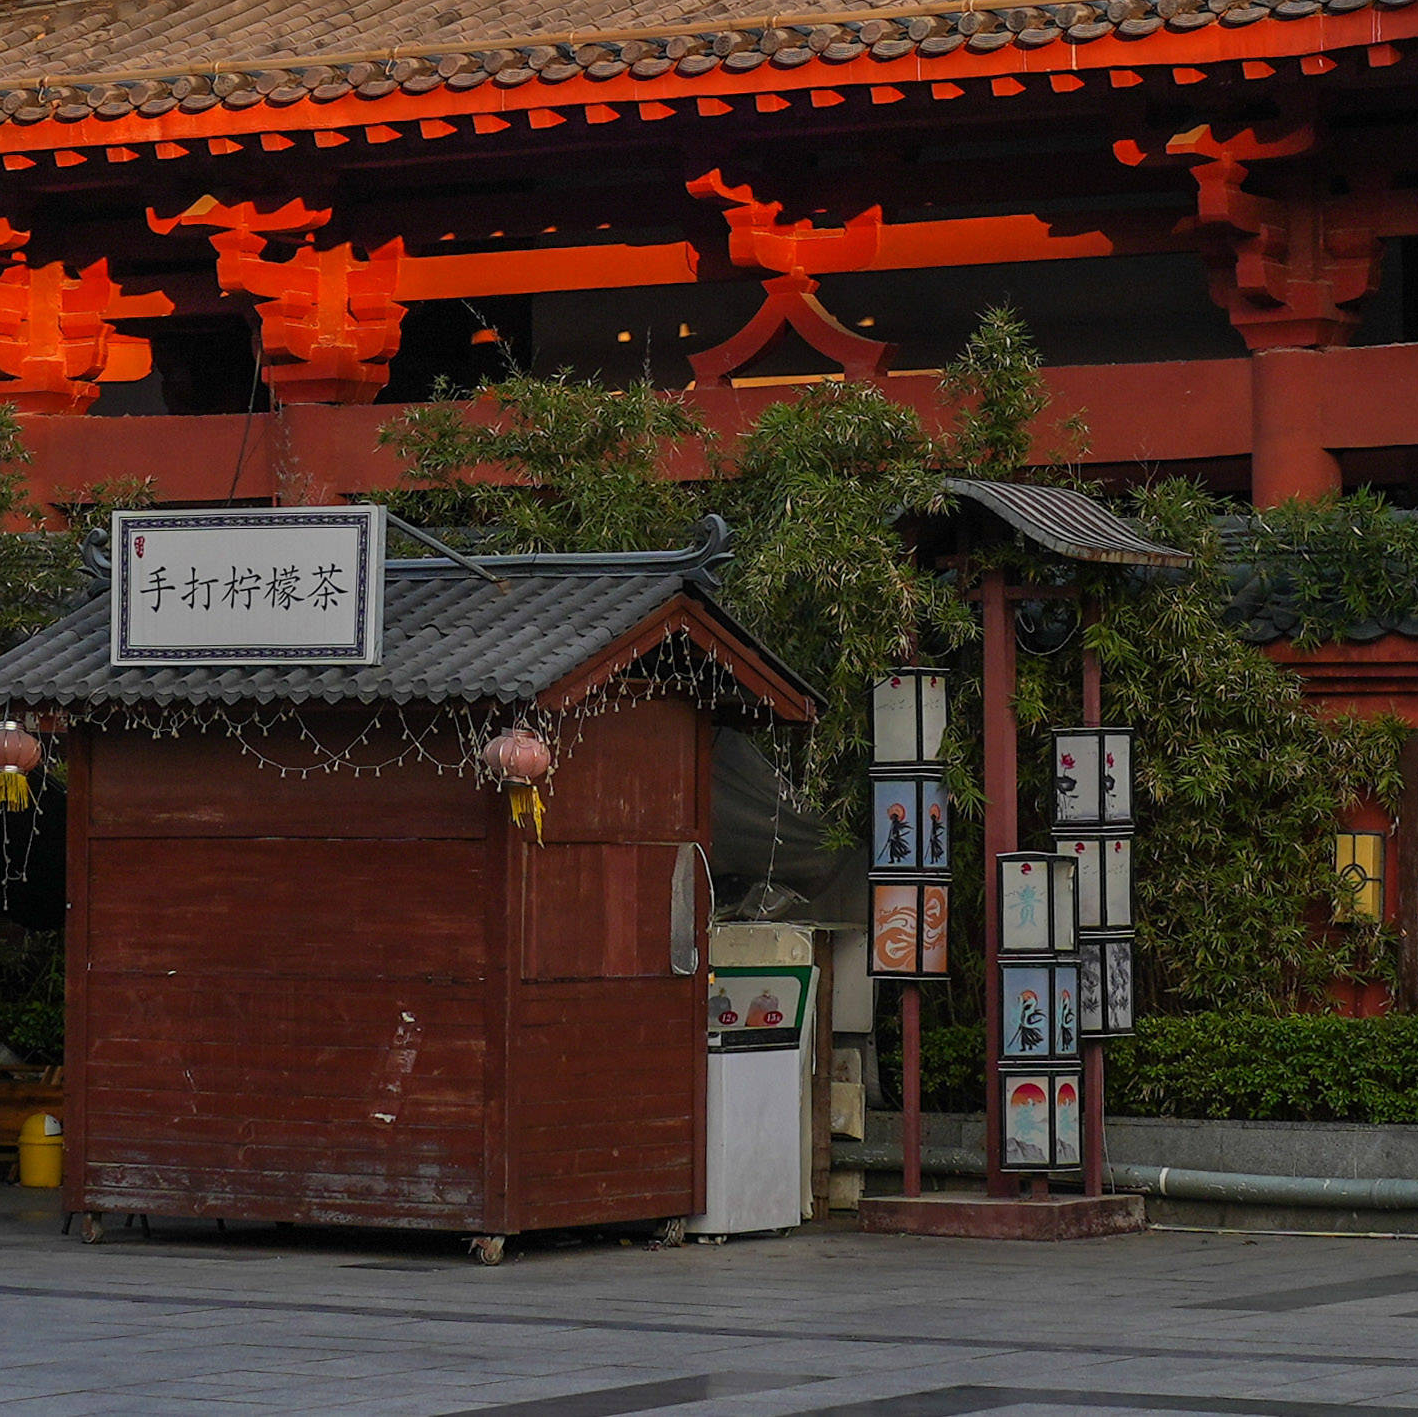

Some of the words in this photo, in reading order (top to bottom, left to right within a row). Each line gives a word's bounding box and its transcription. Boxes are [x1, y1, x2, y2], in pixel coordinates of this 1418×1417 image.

[139, 563, 349, 613] 手打柠檬茶
